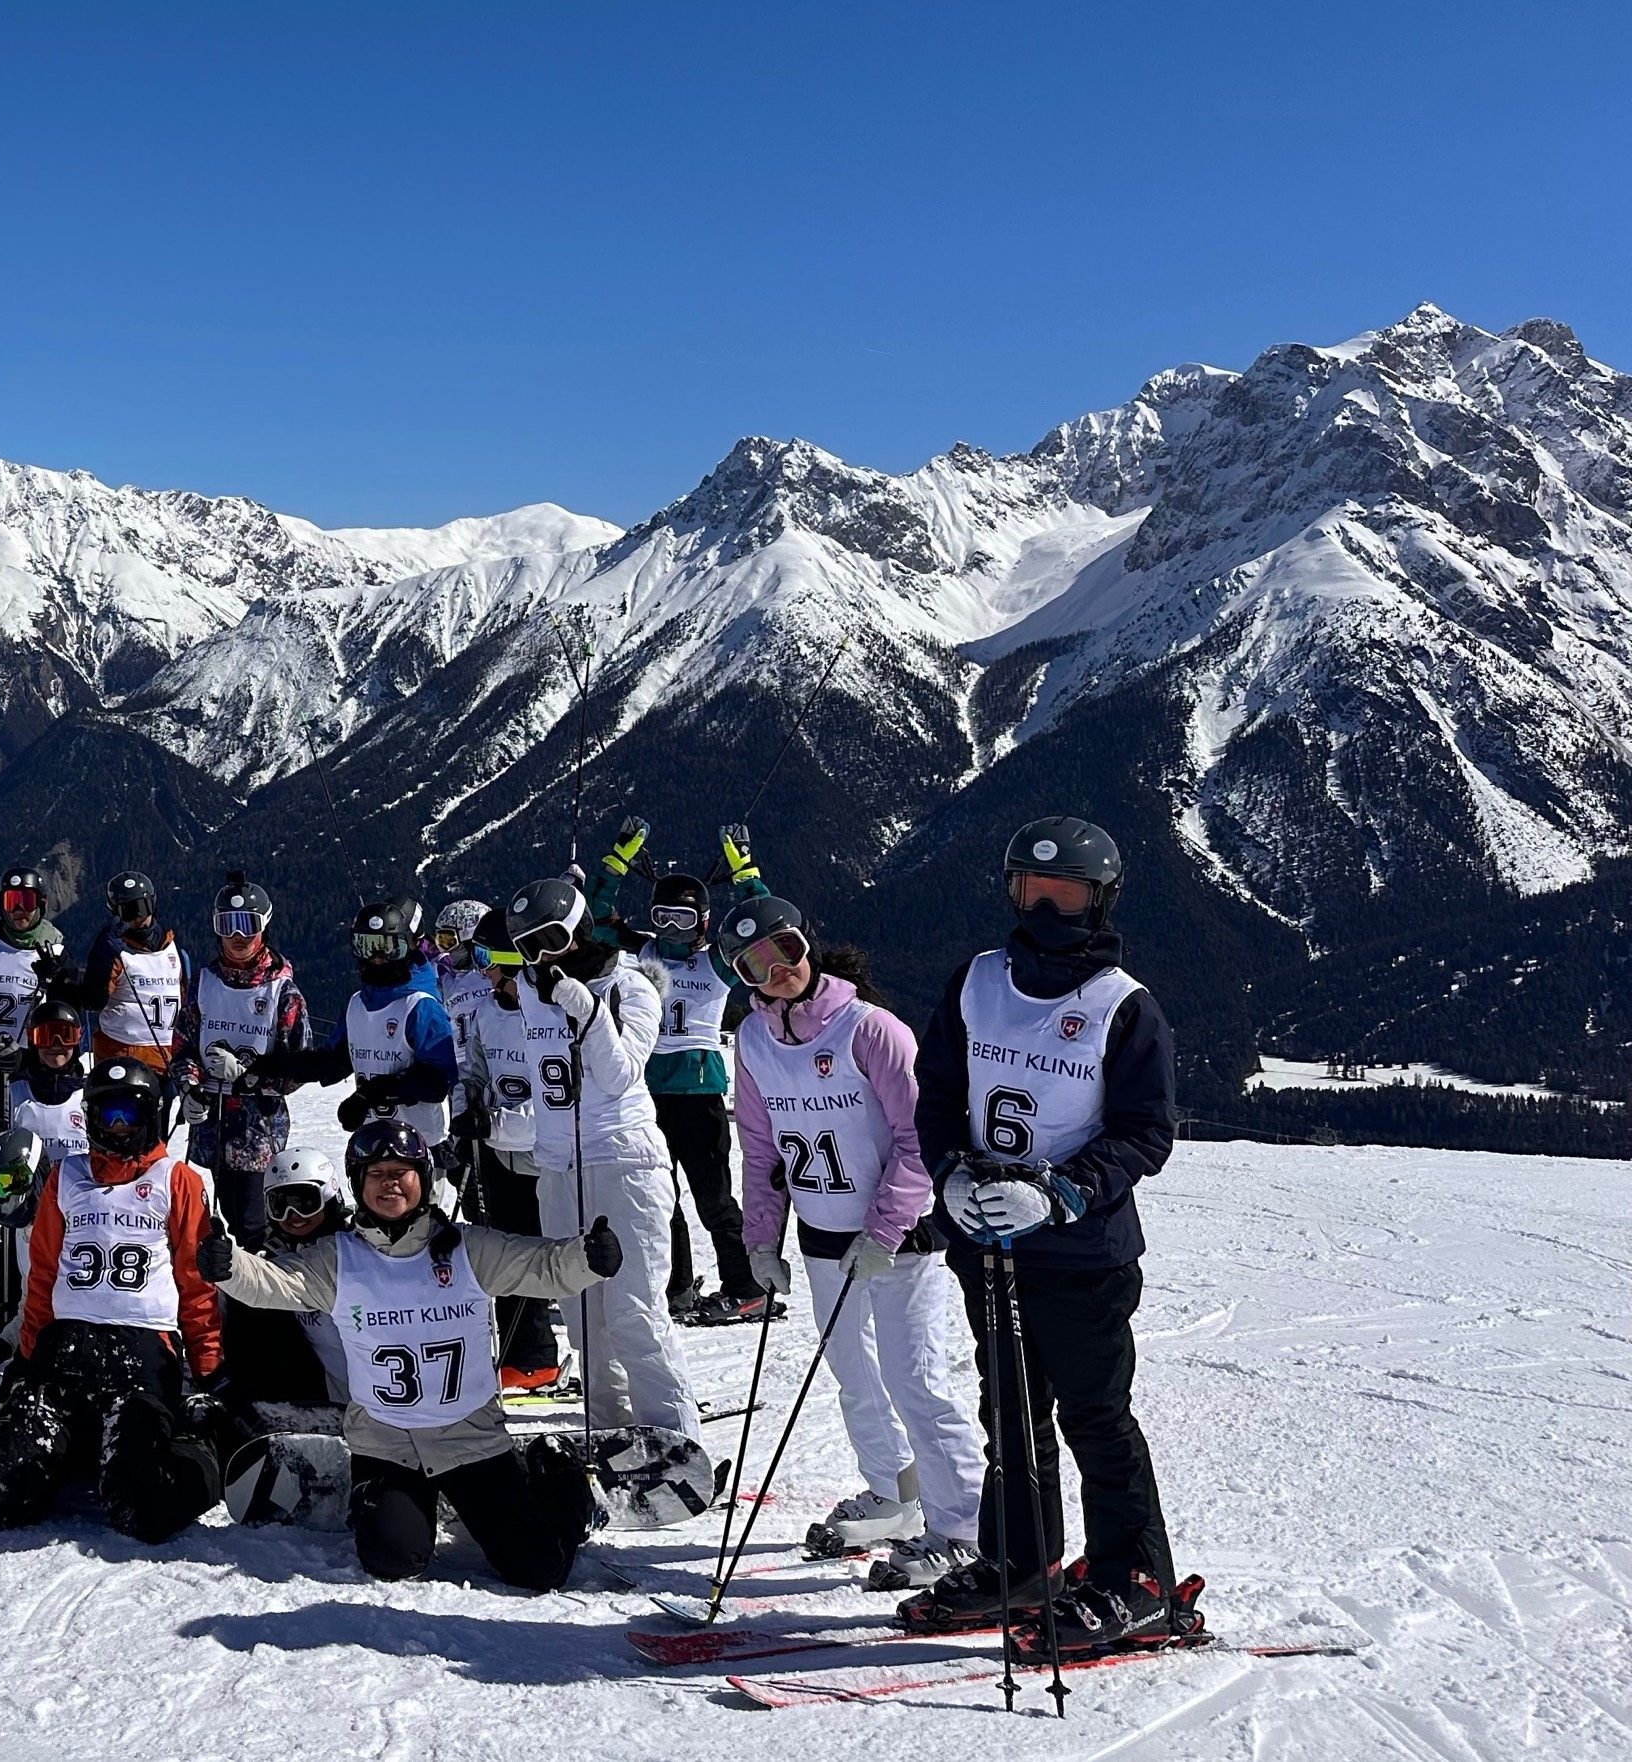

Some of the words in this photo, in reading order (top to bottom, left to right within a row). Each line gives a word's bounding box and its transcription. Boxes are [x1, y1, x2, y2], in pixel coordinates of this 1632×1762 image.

[22, 977, 39, 987] KLI
[139, 976, 164, 987] BERIT
[672, 978, 712, 992] KLINIK
[149, 995, 180, 1030] 17
[208, 1020, 236, 1031] BERIT
[239, 1024, 273, 1038] KLINIK
[527, 1028, 556, 1041] BERIT
[373, 1049, 403, 1062] KLINIK
[507, 1050, 525, 1063] KLI
[972, 1041, 1021, 1066] BERIT
[1025, 1054, 1097, 1081] KLINIK
[539, 1055, 575, 1110] 9
[801, 1091, 864, 1112] KLINIK
[982, 1084, 1039, 1160] 6
[778, 1130, 856, 1194] 21
[72, 1212, 111, 1228] BERIT
[114, 1213, 165, 1231] KLINIK
[66, 1242, 152, 1293] 38
[297, 1313, 322, 1328] NIK
[367, 1309, 415, 1327] BERIT
[421, 1302, 476, 1324] KLINIK
[1010, 1299, 1022, 1337] LEKI
[372, 1336, 467, 1408] 37
[1121, 1607, 1166, 1635] NORDICA
